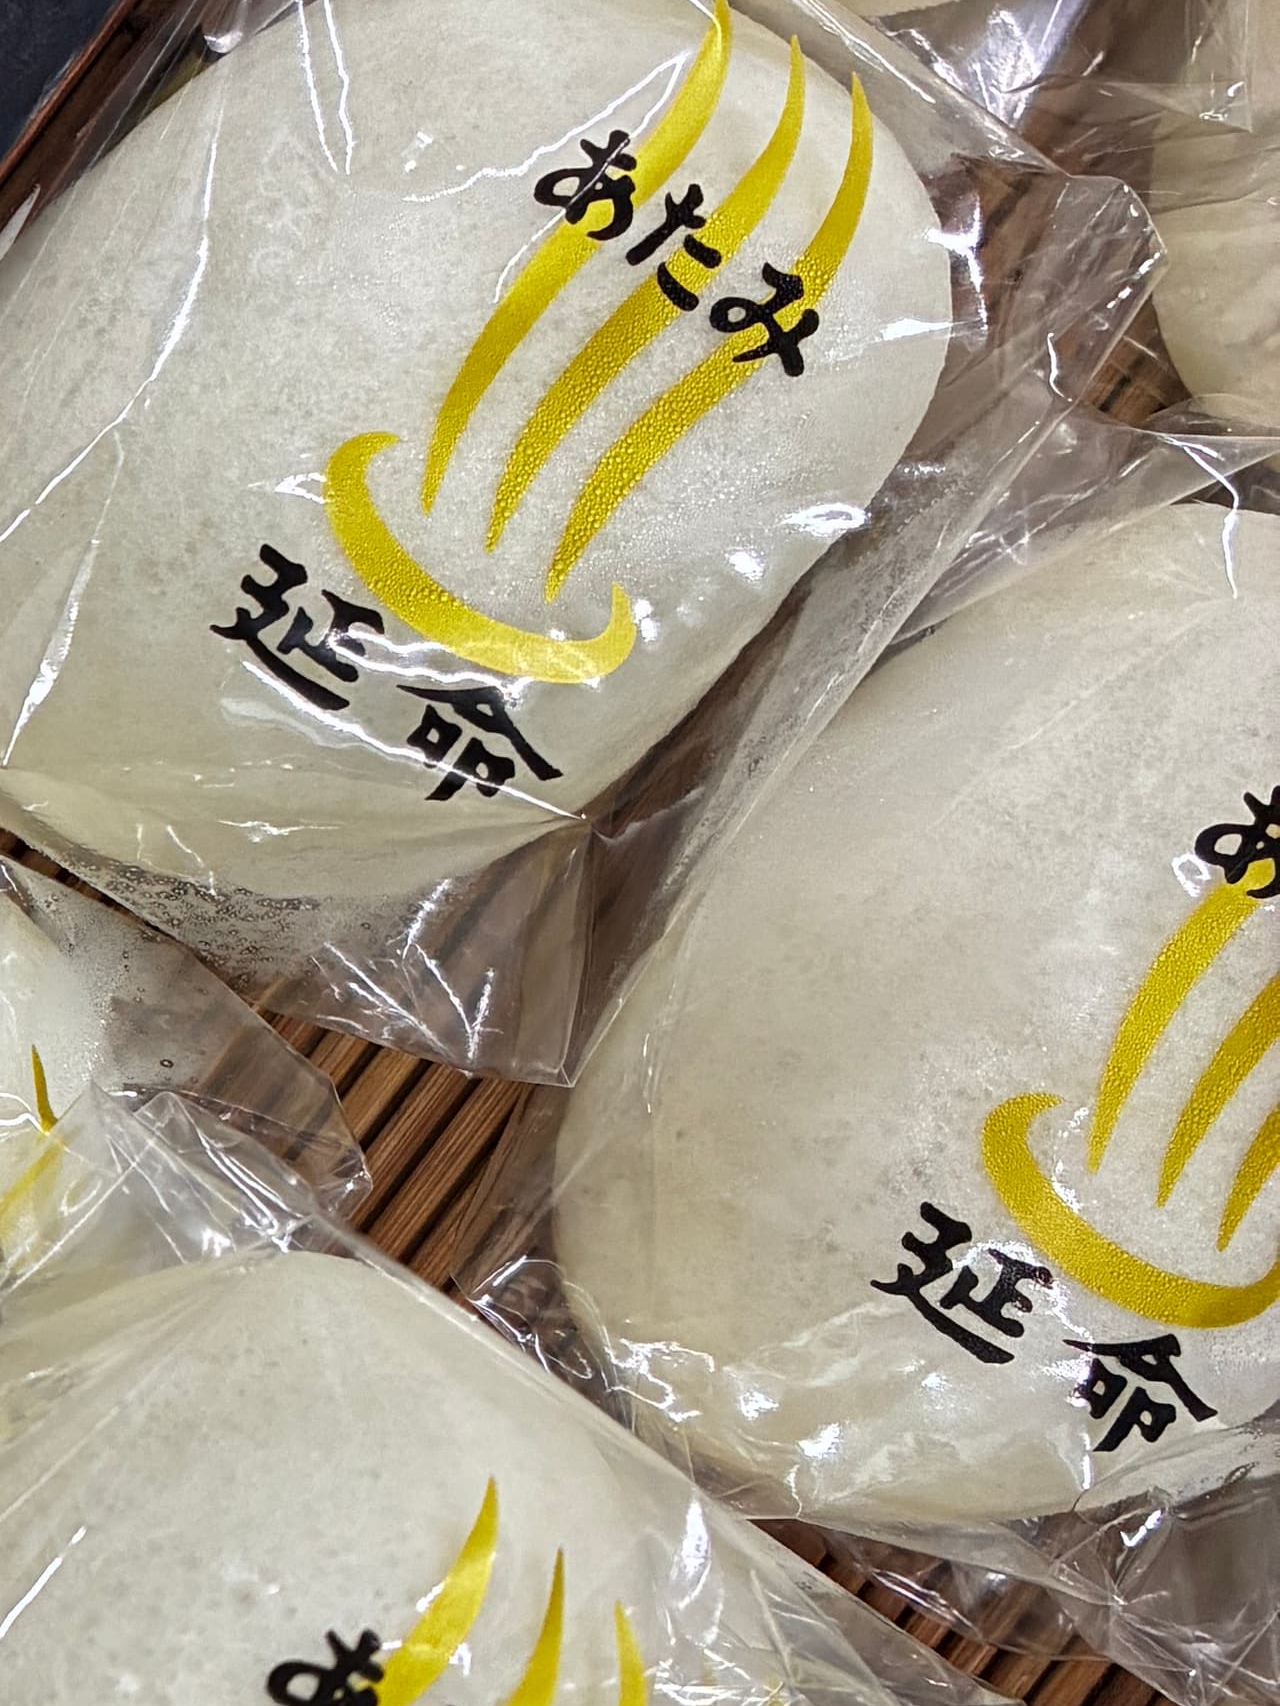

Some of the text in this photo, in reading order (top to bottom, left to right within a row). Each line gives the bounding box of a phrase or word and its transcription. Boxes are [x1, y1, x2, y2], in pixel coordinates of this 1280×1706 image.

[533, 129, 821, 378] あたみ
[209, 542, 564, 802] 延命
[869, 1200, 1219, 1453] 延命
